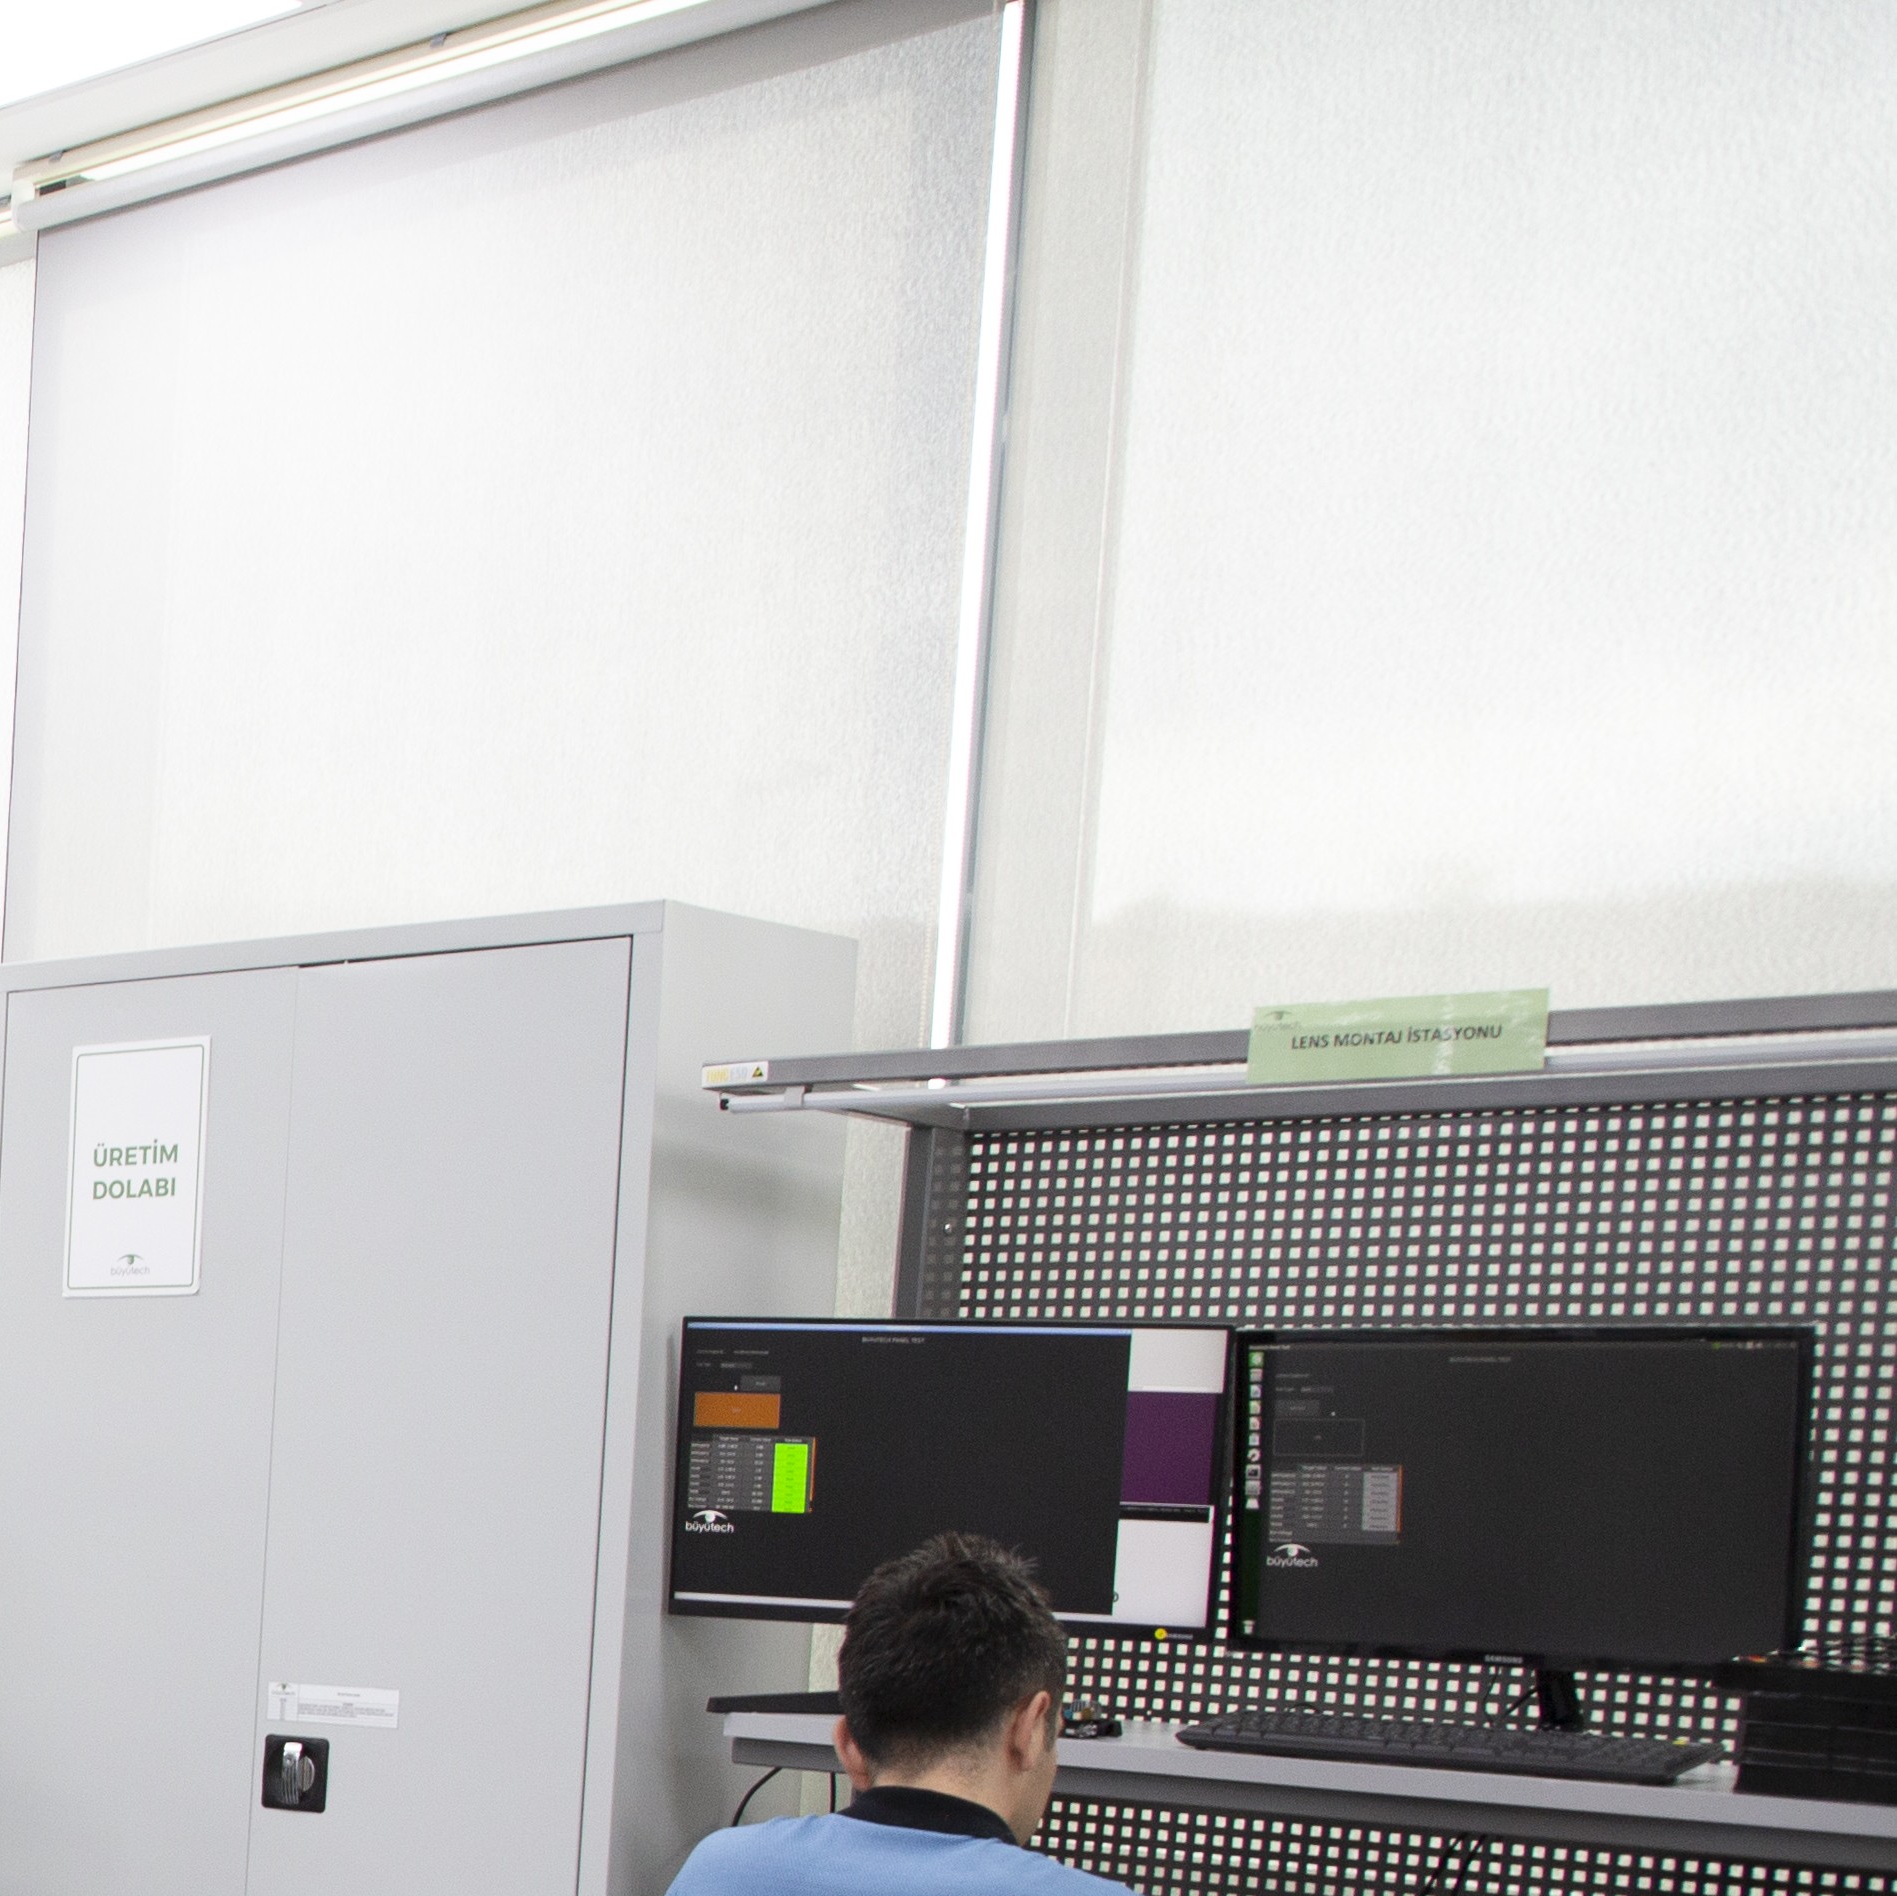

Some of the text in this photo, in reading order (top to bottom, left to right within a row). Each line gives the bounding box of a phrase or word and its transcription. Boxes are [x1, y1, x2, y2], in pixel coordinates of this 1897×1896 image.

[1291, 1034, 1330, 1050] LENS
[1333, 1030, 1404, 1048] MONTAJ
[93, 1138, 179, 1168] ÜRETİM
[92, 1177, 177, 1200] DOLABI
